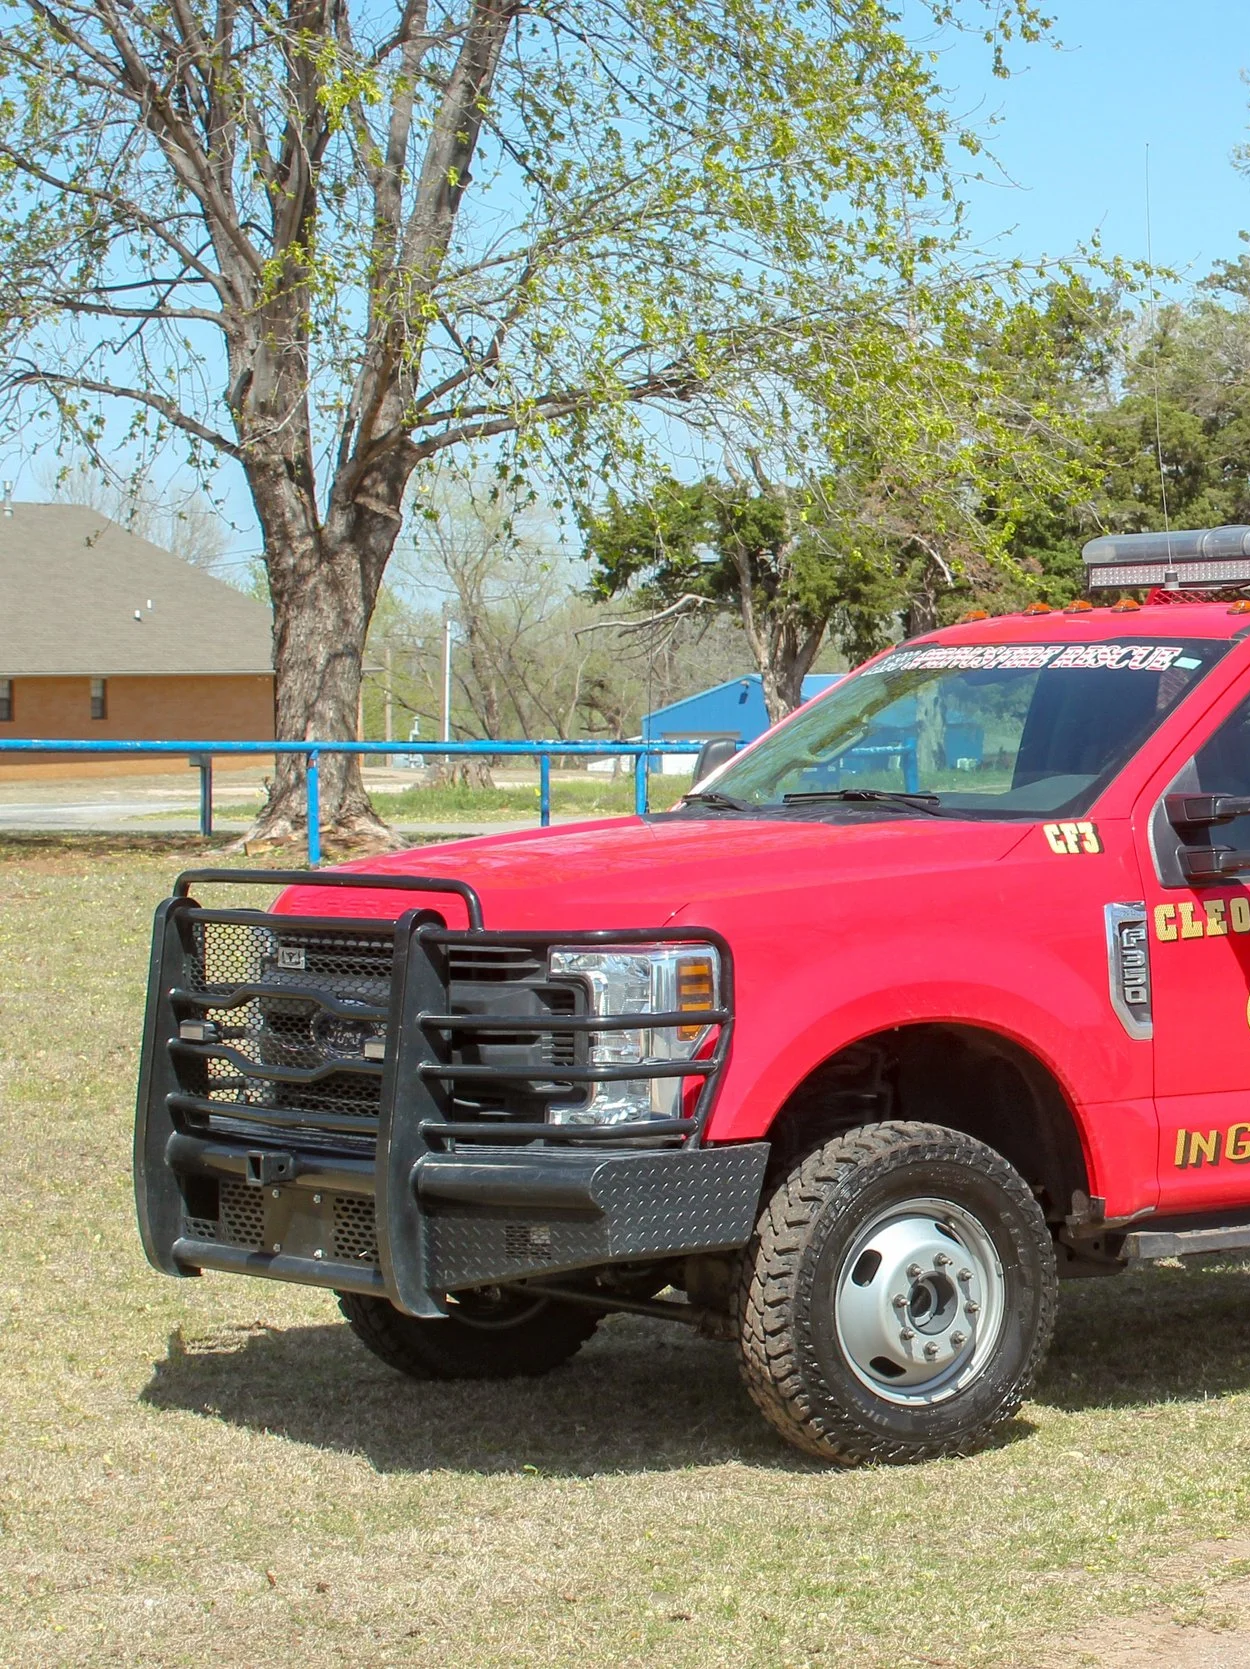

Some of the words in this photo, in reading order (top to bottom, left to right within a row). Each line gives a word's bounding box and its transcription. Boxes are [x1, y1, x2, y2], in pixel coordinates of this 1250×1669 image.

[983, 645, 1061, 669] FIRE
[1047, 645, 1182, 671] RESCUE
[1042, 821, 1105, 855] CF3
